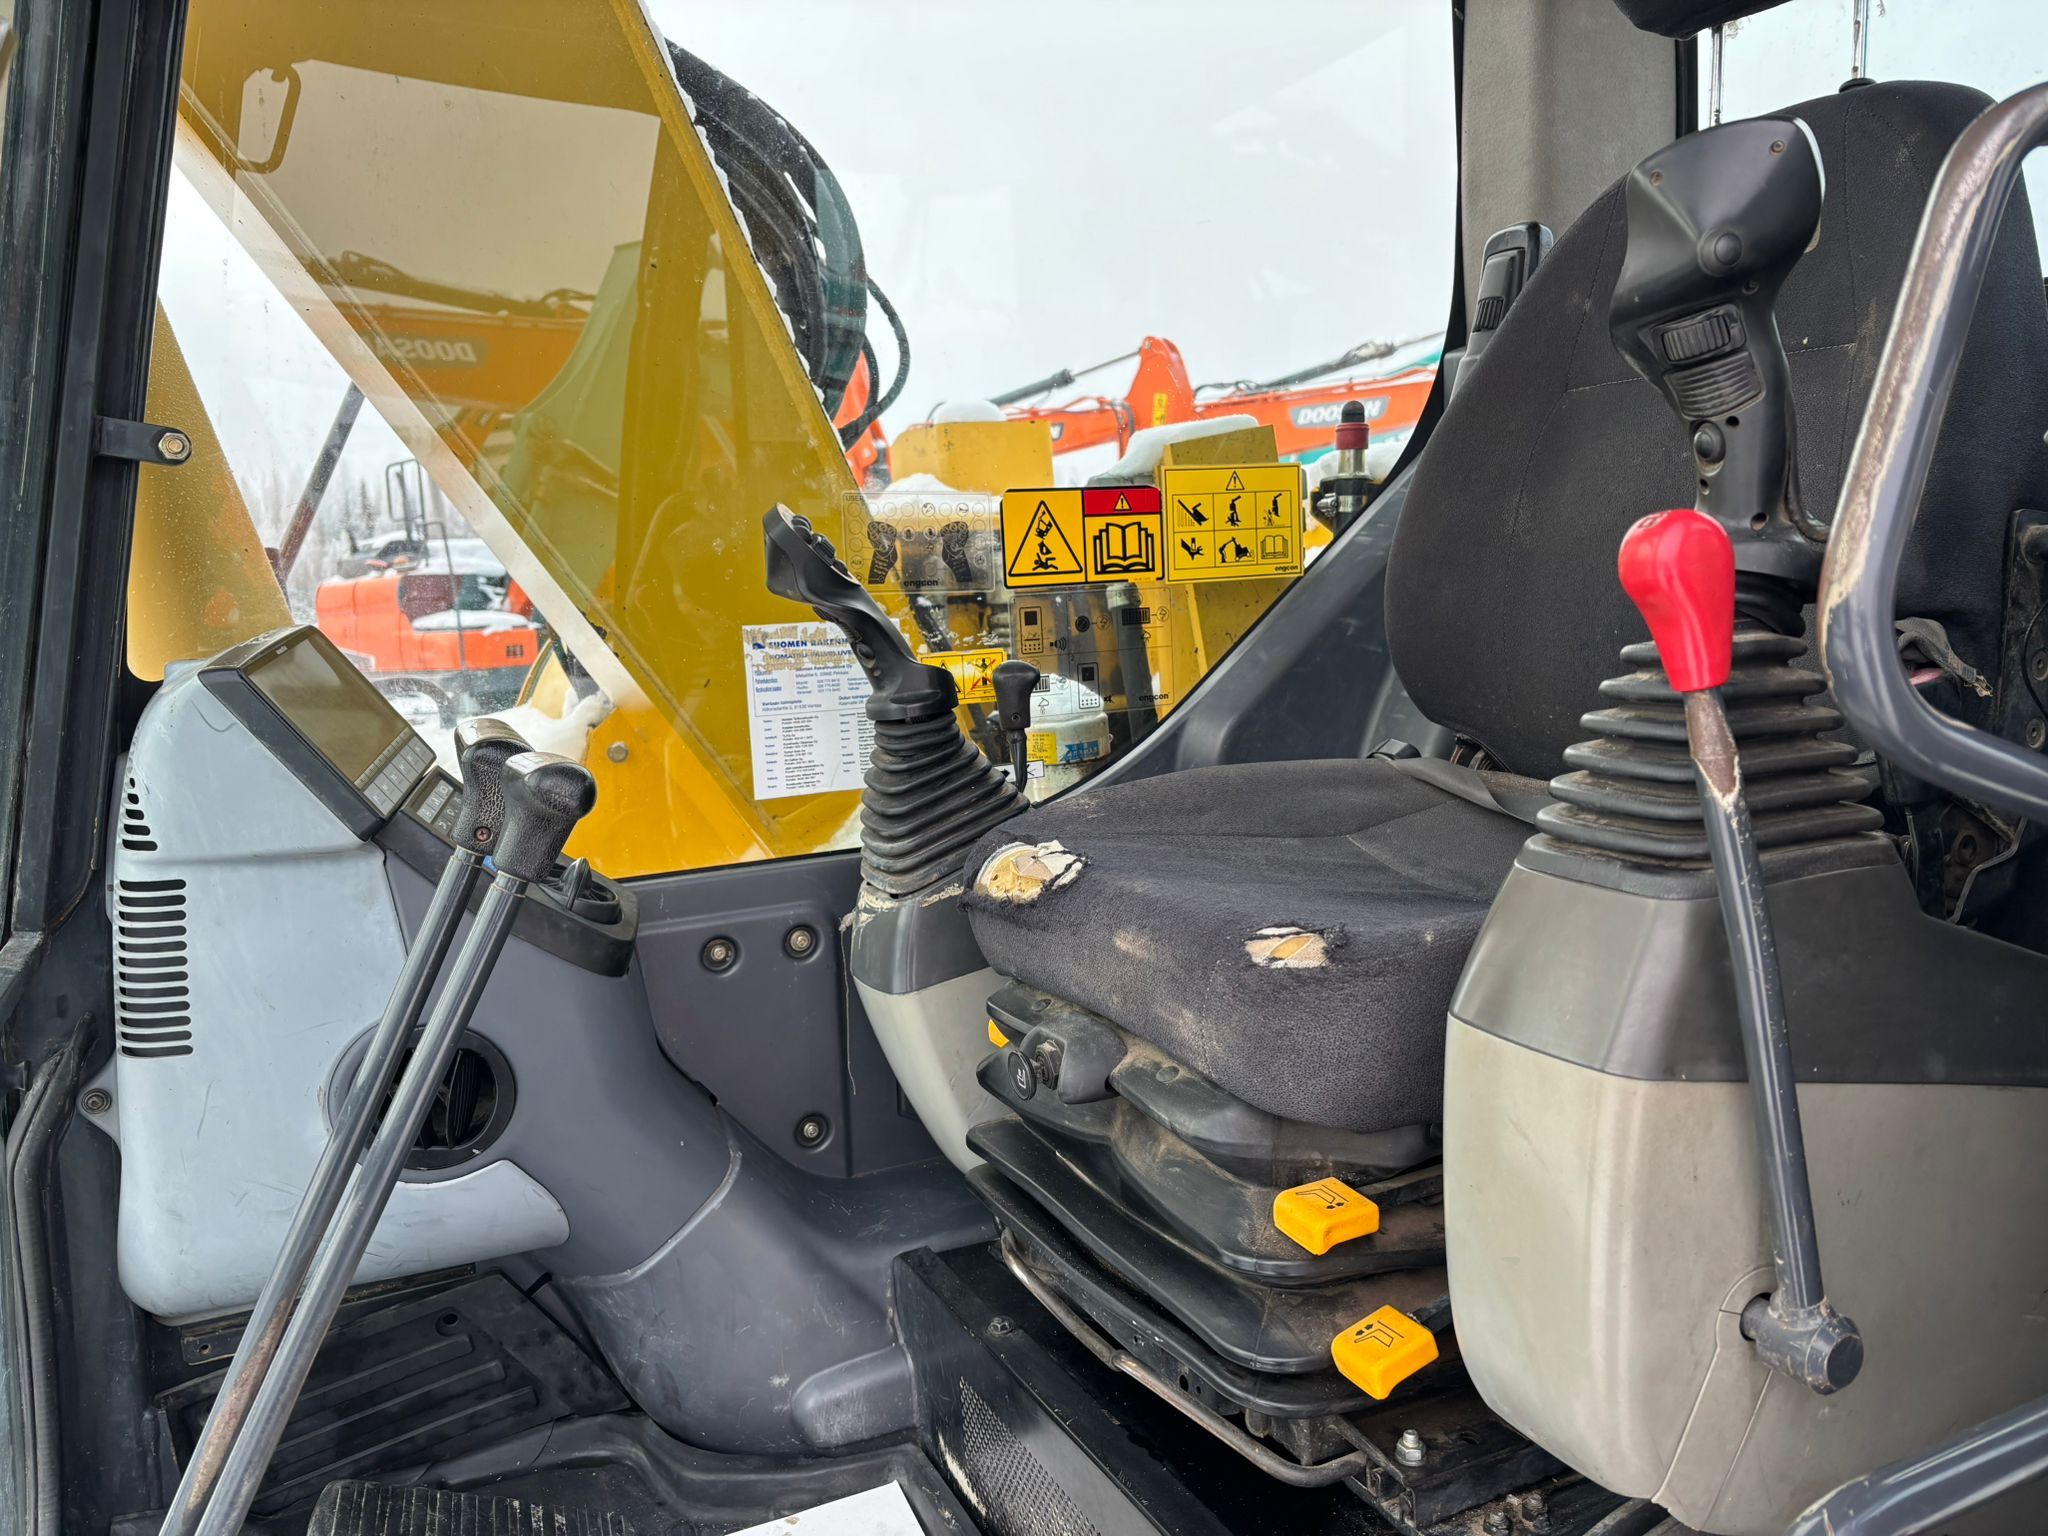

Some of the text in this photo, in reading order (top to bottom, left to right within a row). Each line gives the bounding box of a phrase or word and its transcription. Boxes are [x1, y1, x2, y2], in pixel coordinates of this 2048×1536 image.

[1296, 399, 1382, 425] DOON
[903, 579, 939, 588] engcon
[1138, 693, 1169, 702] engcon
